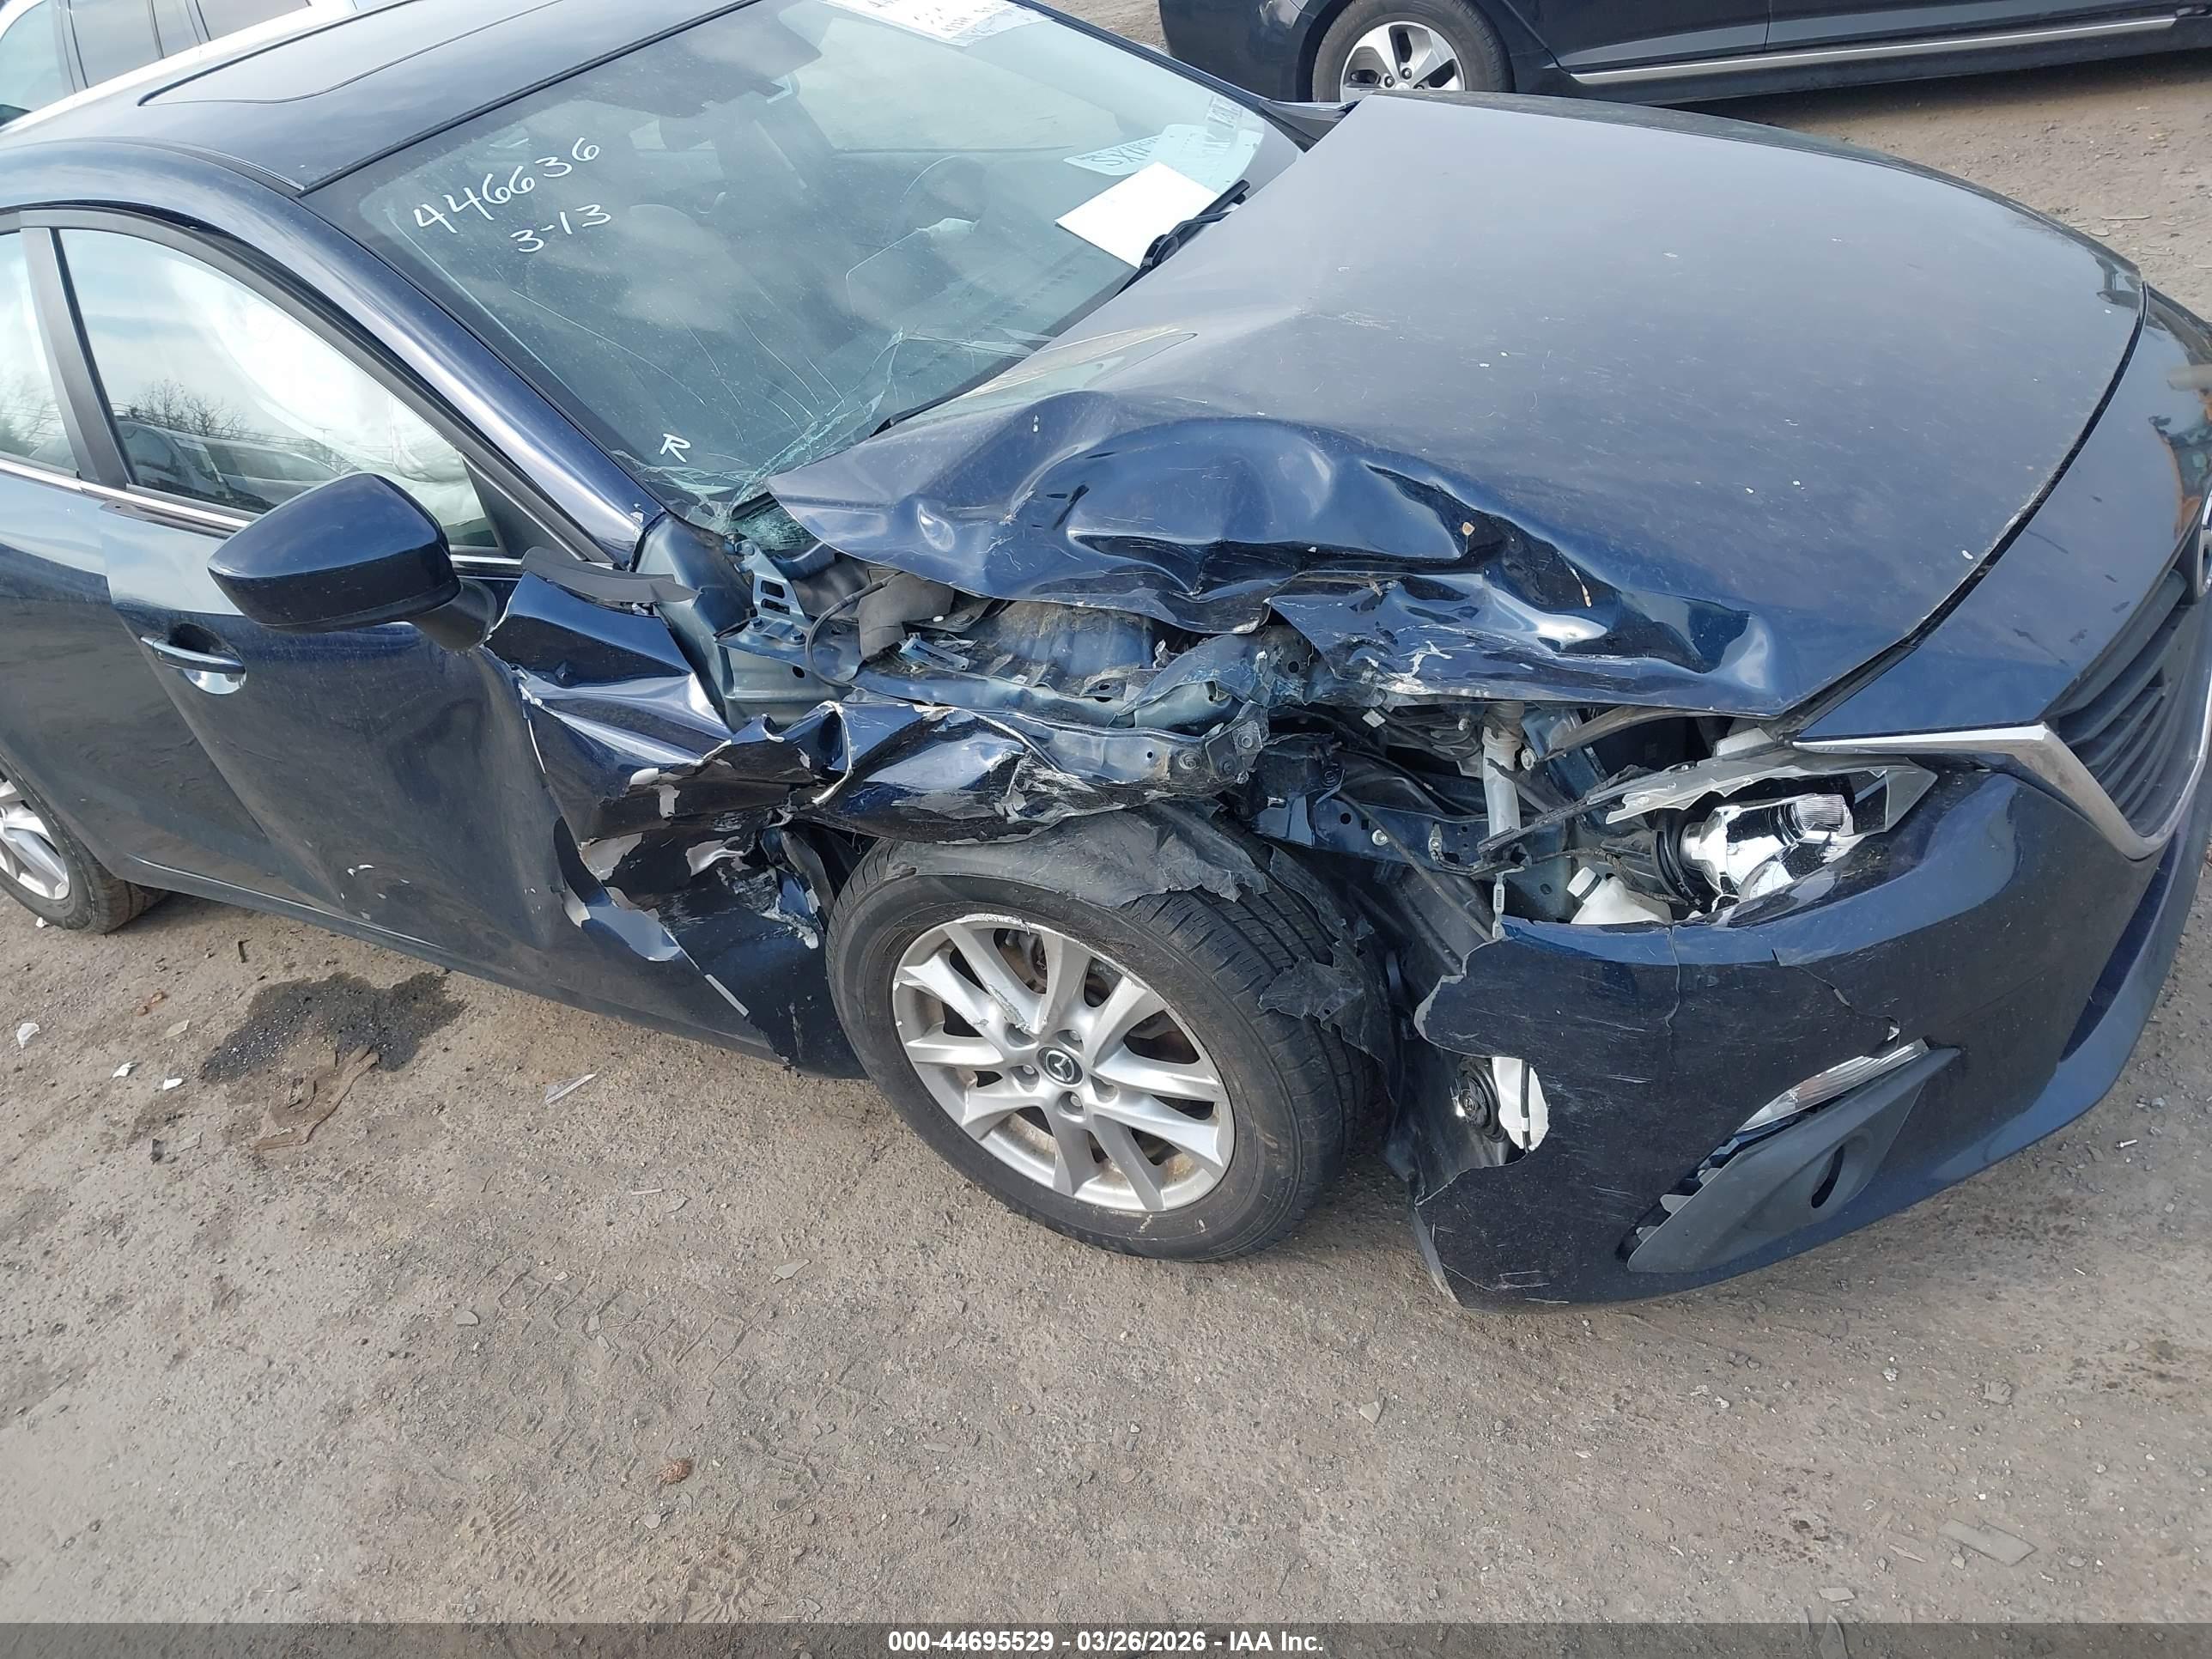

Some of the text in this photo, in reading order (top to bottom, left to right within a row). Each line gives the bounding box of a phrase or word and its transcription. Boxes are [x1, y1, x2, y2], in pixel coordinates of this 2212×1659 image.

[414, 137, 600, 234] 446636
[510, 204, 611, 253] 3-13
[659, 433, 691, 463] R
